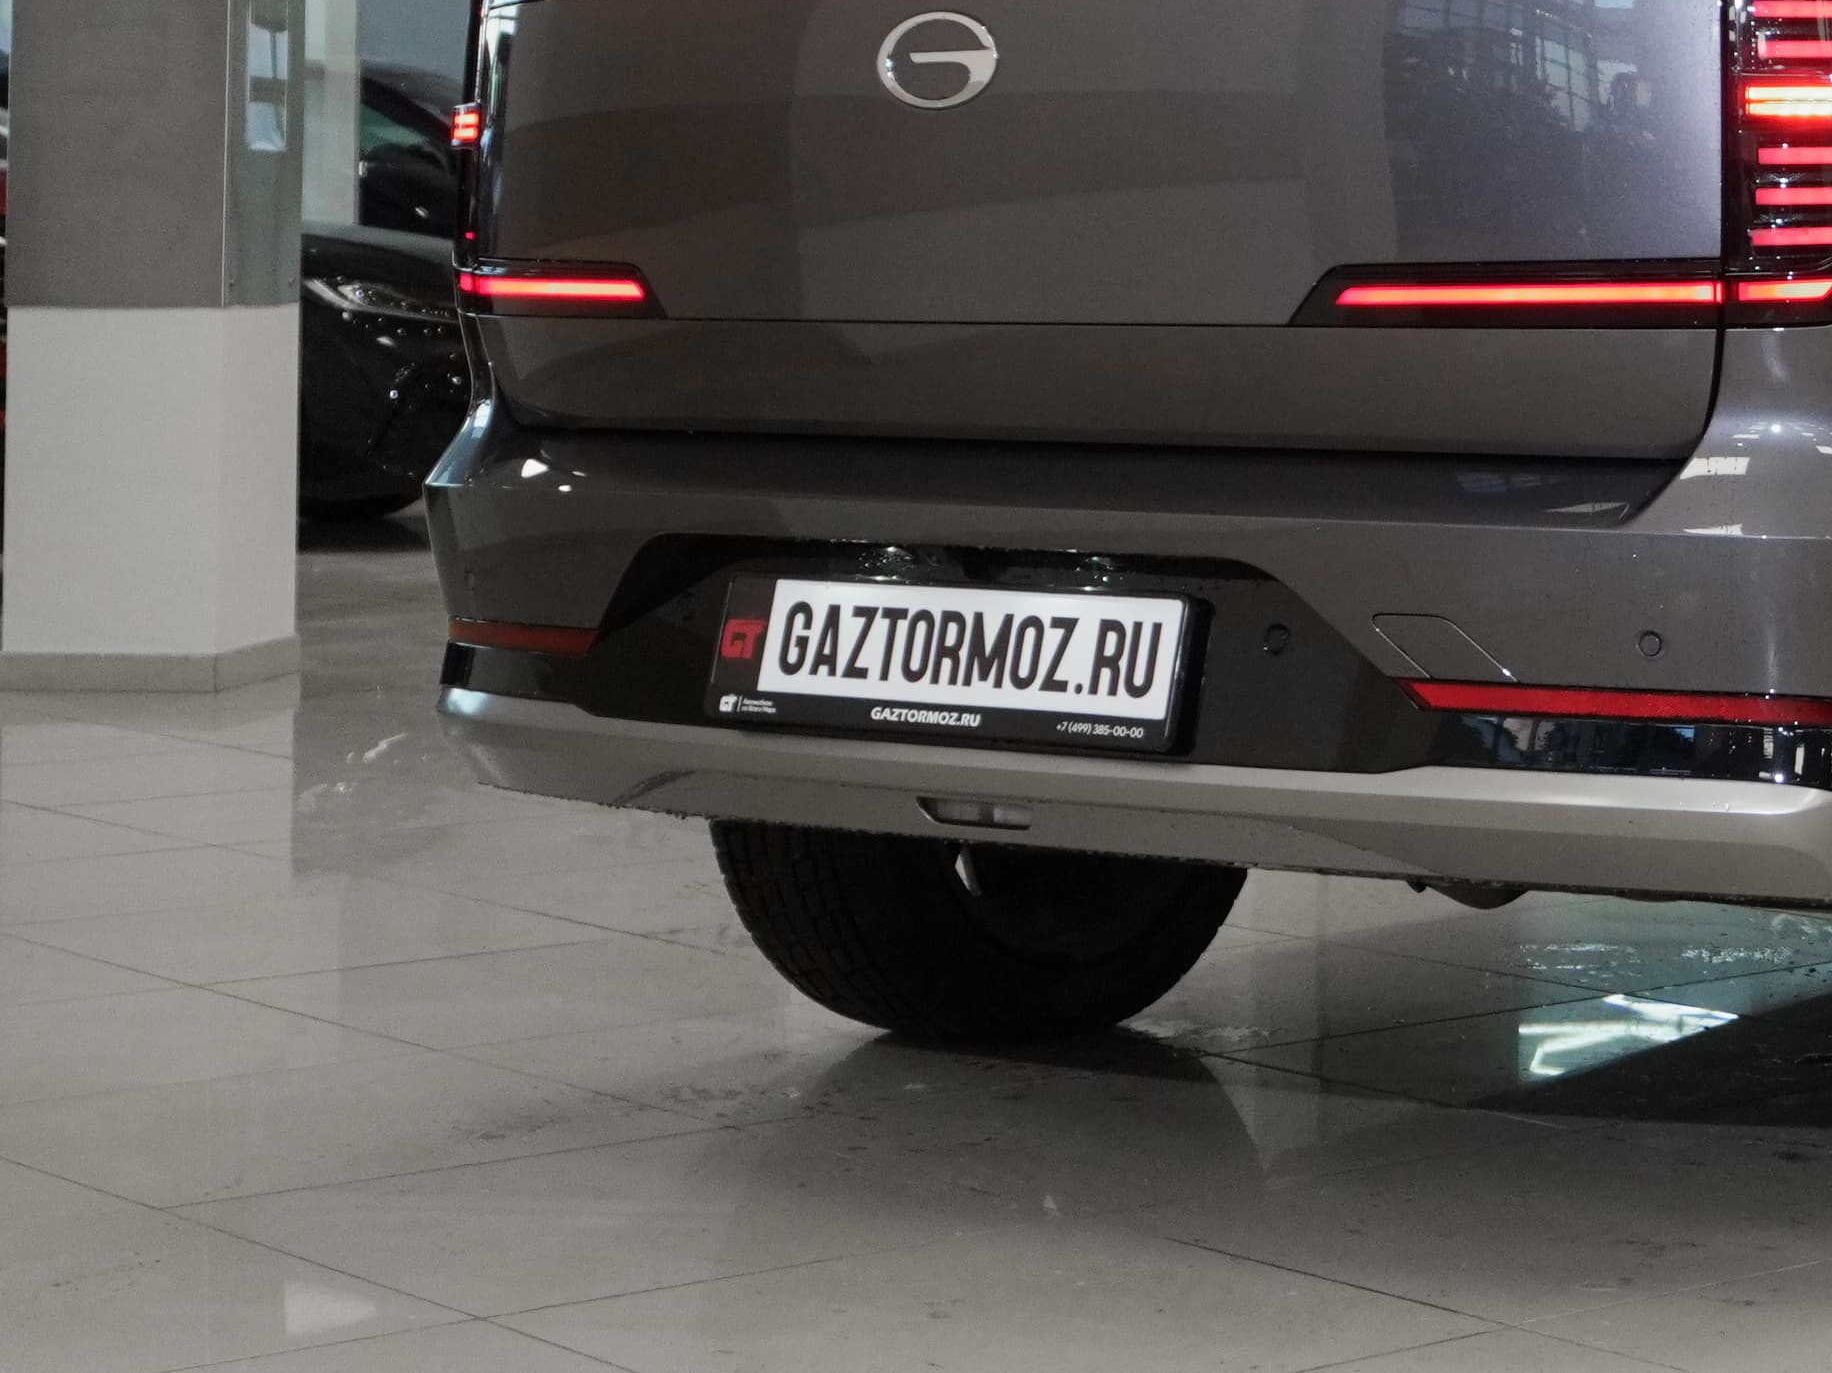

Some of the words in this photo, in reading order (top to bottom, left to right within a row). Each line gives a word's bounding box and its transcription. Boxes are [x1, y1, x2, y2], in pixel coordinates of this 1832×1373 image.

[778, 600, 1163, 699] GAZTORMOZ.RU
[870, 706, 981, 727] GAZTORMOZ.RU
[1068, 721, 1092, 736] (499)
[1092, 723, 1144, 739] 385-00-00
